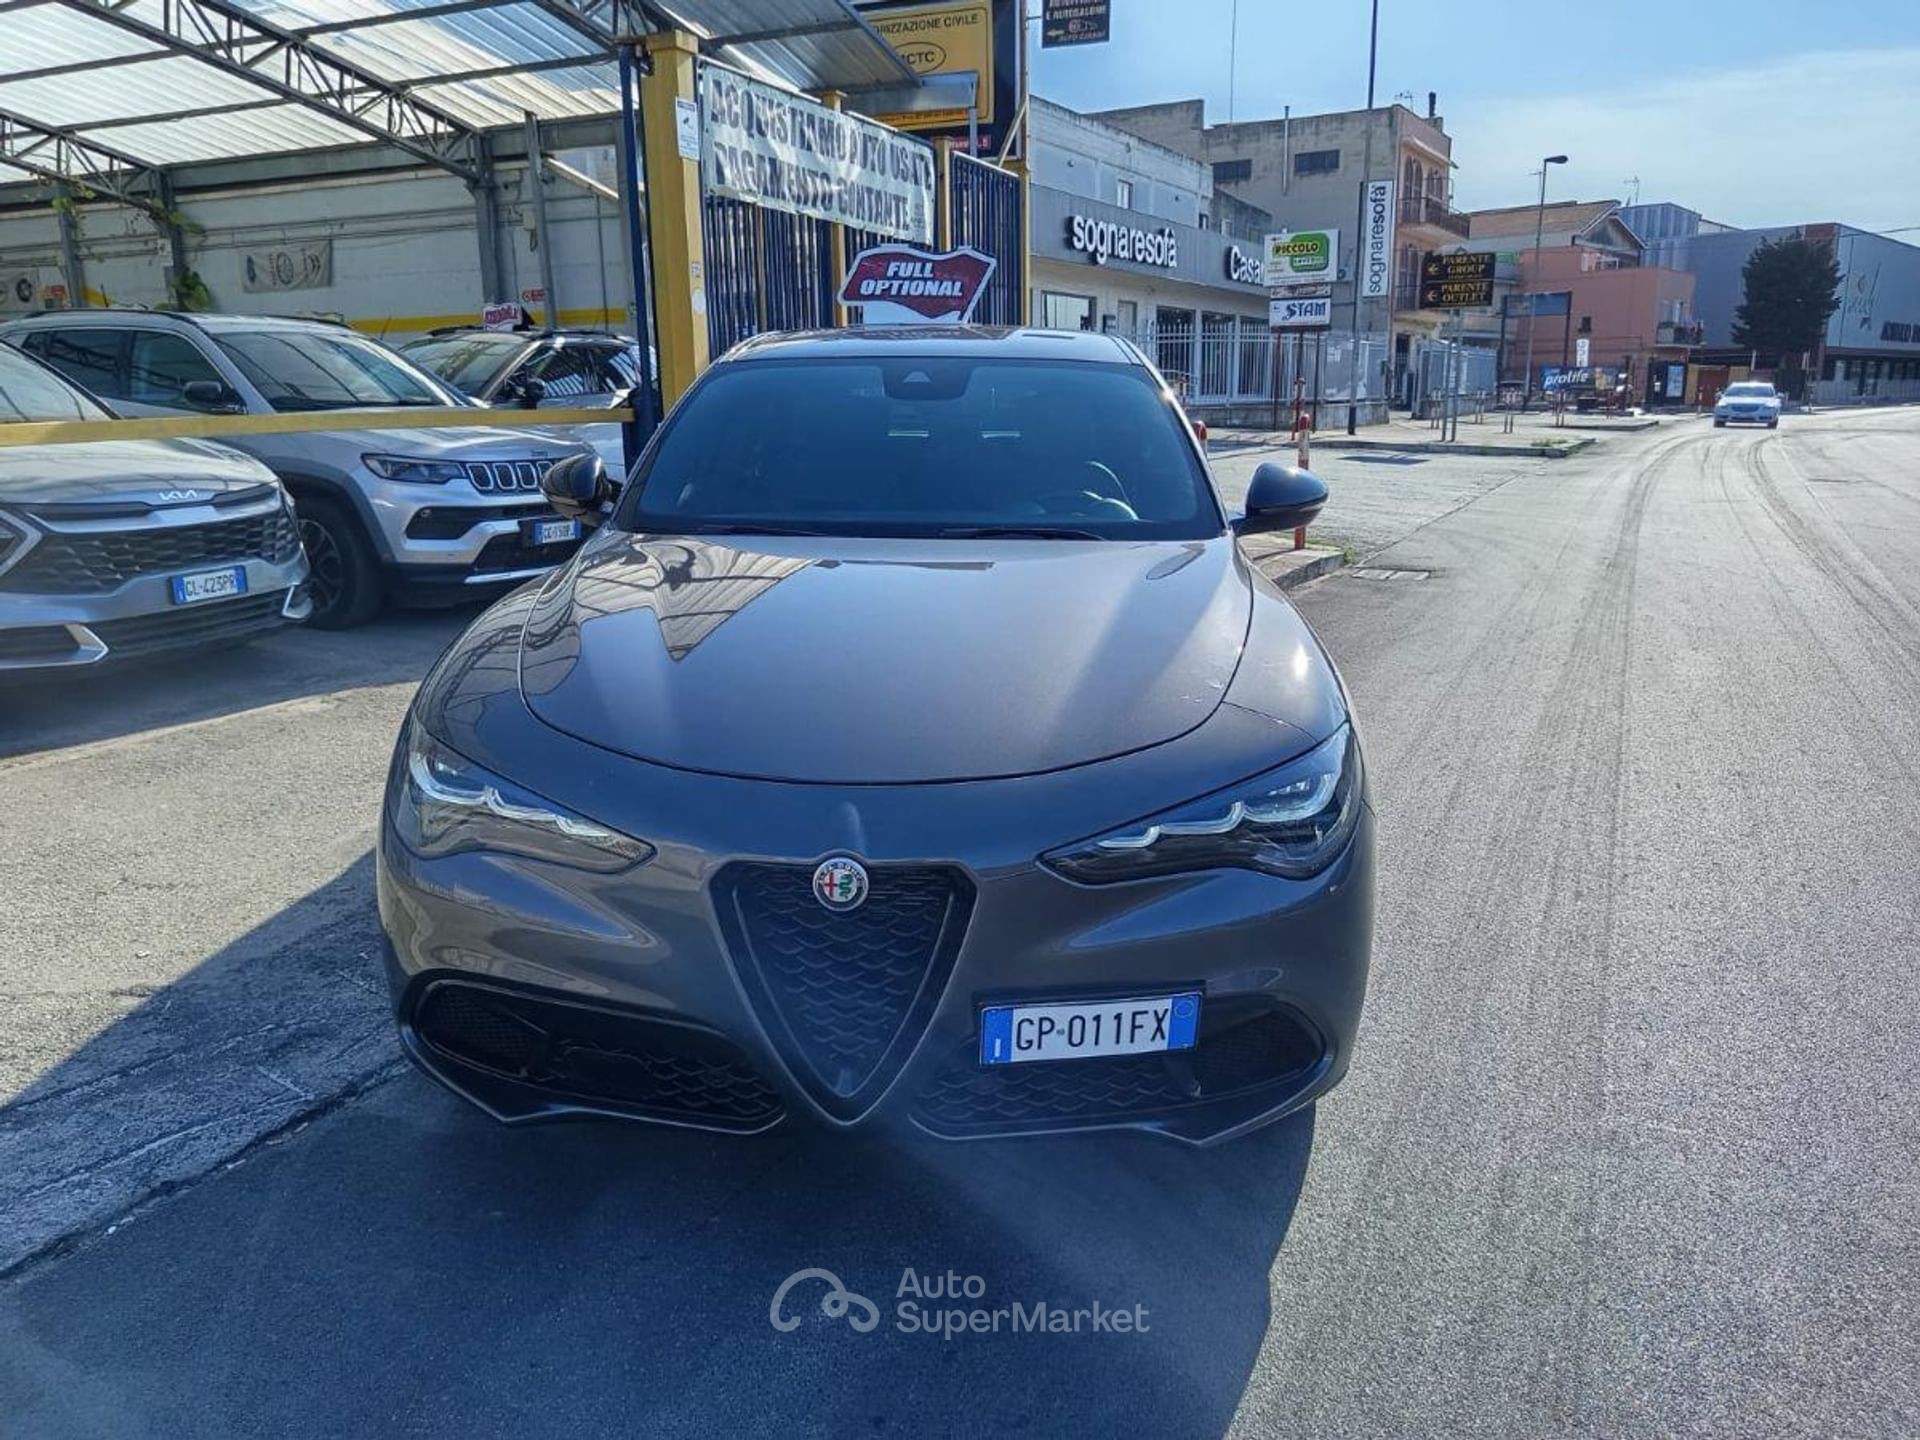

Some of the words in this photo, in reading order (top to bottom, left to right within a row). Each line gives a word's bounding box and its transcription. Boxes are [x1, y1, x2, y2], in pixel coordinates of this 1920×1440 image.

[944, 13, 979, 28] CIVILE
[901, 51, 936, 65] CTC
[711, 79, 847, 162] ACQUISTIAMO
[849, 125, 887, 176] AUTO
[714, 141, 834, 210] PAGAMENTO
[838, 178, 910, 231] CONTANTE
[1073, 215, 1178, 268] sognaresofà
[1273, 243, 1318, 254] PICCOLO
[1368, 185, 1387, 293] sognaresofà
[887, 262, 934, 277] FULL
[1230, 245, 1264, 285] Casa
[860, 280, 963, 296] OPTIONAL
[1281, 302, 1326, 320] STAM
[1544, 369, 1589, 389] prolife
